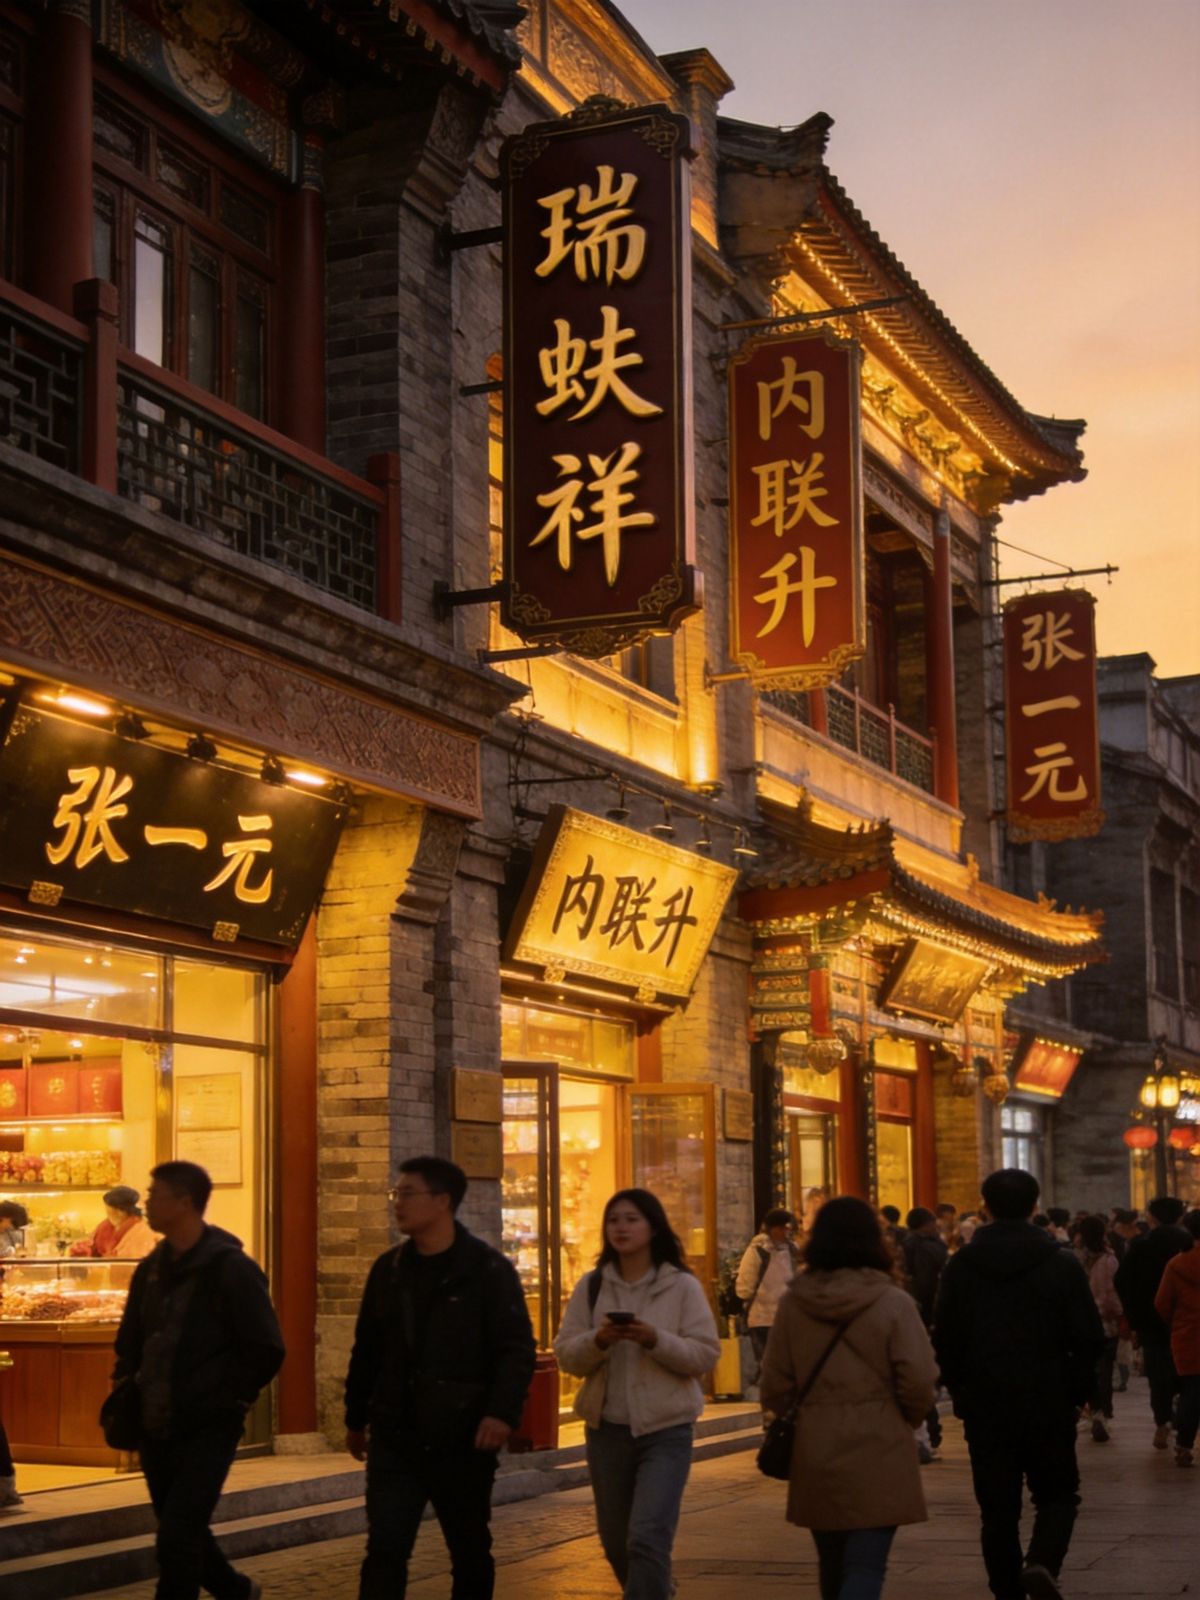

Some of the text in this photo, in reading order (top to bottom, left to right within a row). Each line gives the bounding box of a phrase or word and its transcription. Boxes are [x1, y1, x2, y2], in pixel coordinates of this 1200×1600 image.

[529, 165, 663, 586] 瑞蚨祥
[750, 356, 840, 649] 内联升
[1020, 611, 1088, 802] 张一元
[45, 765, 274, 904] 张一元
[551, 854, 699, 969] 内联升
